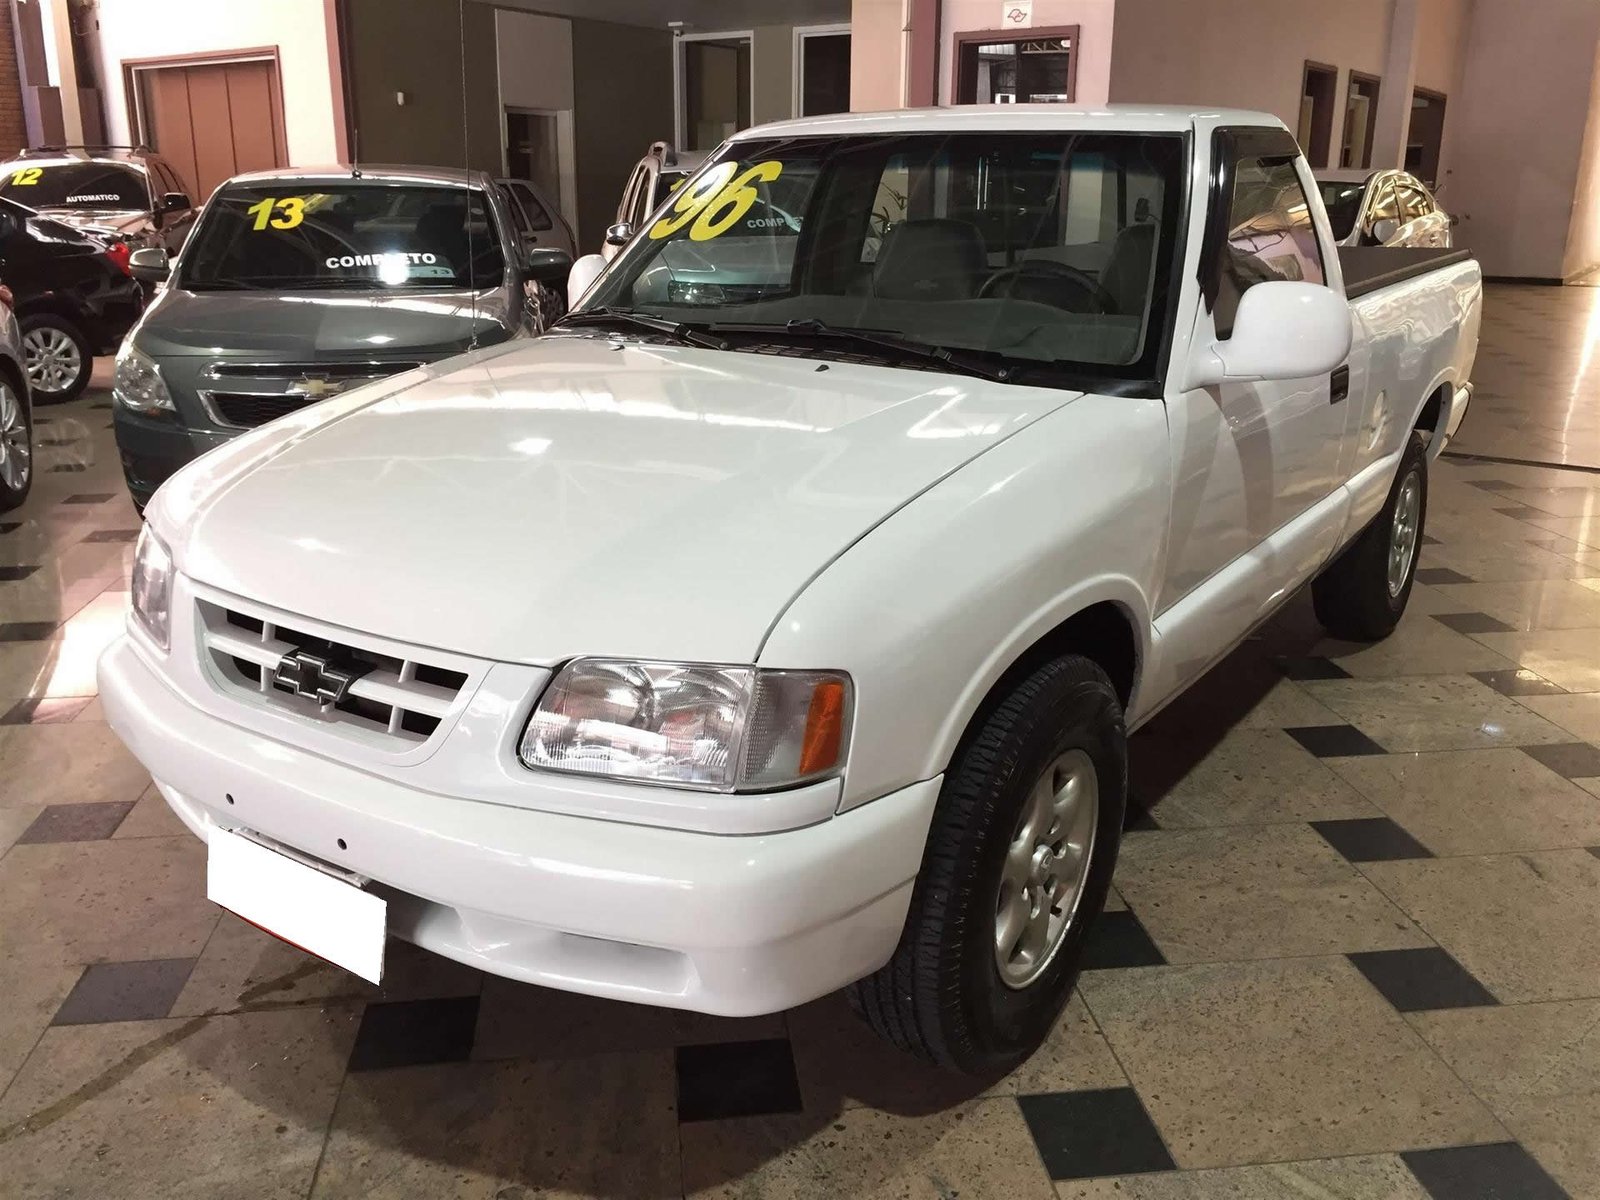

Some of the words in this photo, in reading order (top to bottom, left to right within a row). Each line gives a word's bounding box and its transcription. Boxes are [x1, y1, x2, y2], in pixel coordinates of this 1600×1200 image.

[11, 168, 43, 186] 12
[66, 194, 120, 204] AUTOMATICO
[649, 160, 783, 241] 96
[247, 197, 305, 231] 13
